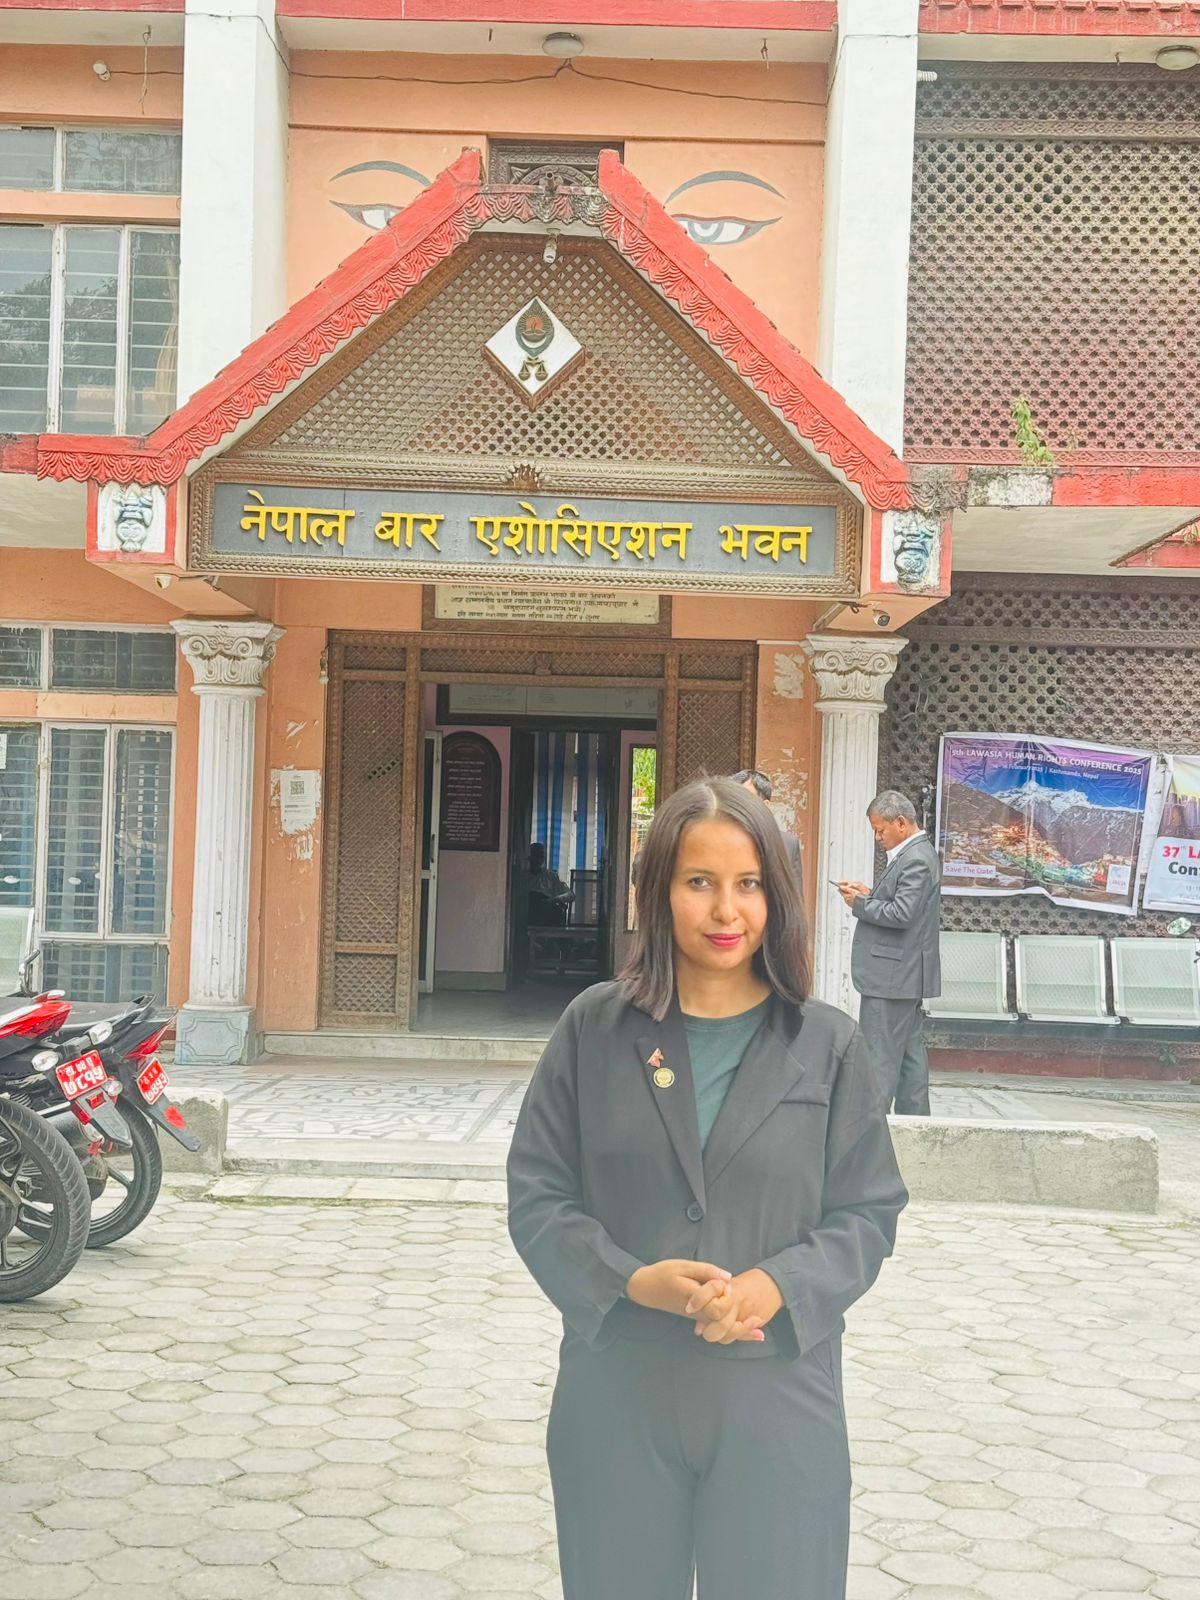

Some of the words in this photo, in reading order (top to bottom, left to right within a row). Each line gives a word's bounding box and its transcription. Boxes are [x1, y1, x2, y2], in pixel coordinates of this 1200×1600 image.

[240, 490, 355, 546] नेपाल
[374, 511, 444, 552] बार
[470, 501, 693, 560] एशोसिएशन
[719, 524, 813, 565] भवन
[966, 749, 1003, 759] LAWASIA
[1005, 751, 1036, 762] HUMAN
[1037, 755, 1067, 766] RIGHTS
[1069, 758, 1122, 773] CONFERENCE
[1124, 766, 1143, 776] 2025
[945, 865, 962, 873] Save
[977, 867, 994, 875] Date
[1168, 861, 1200, 876] Con
